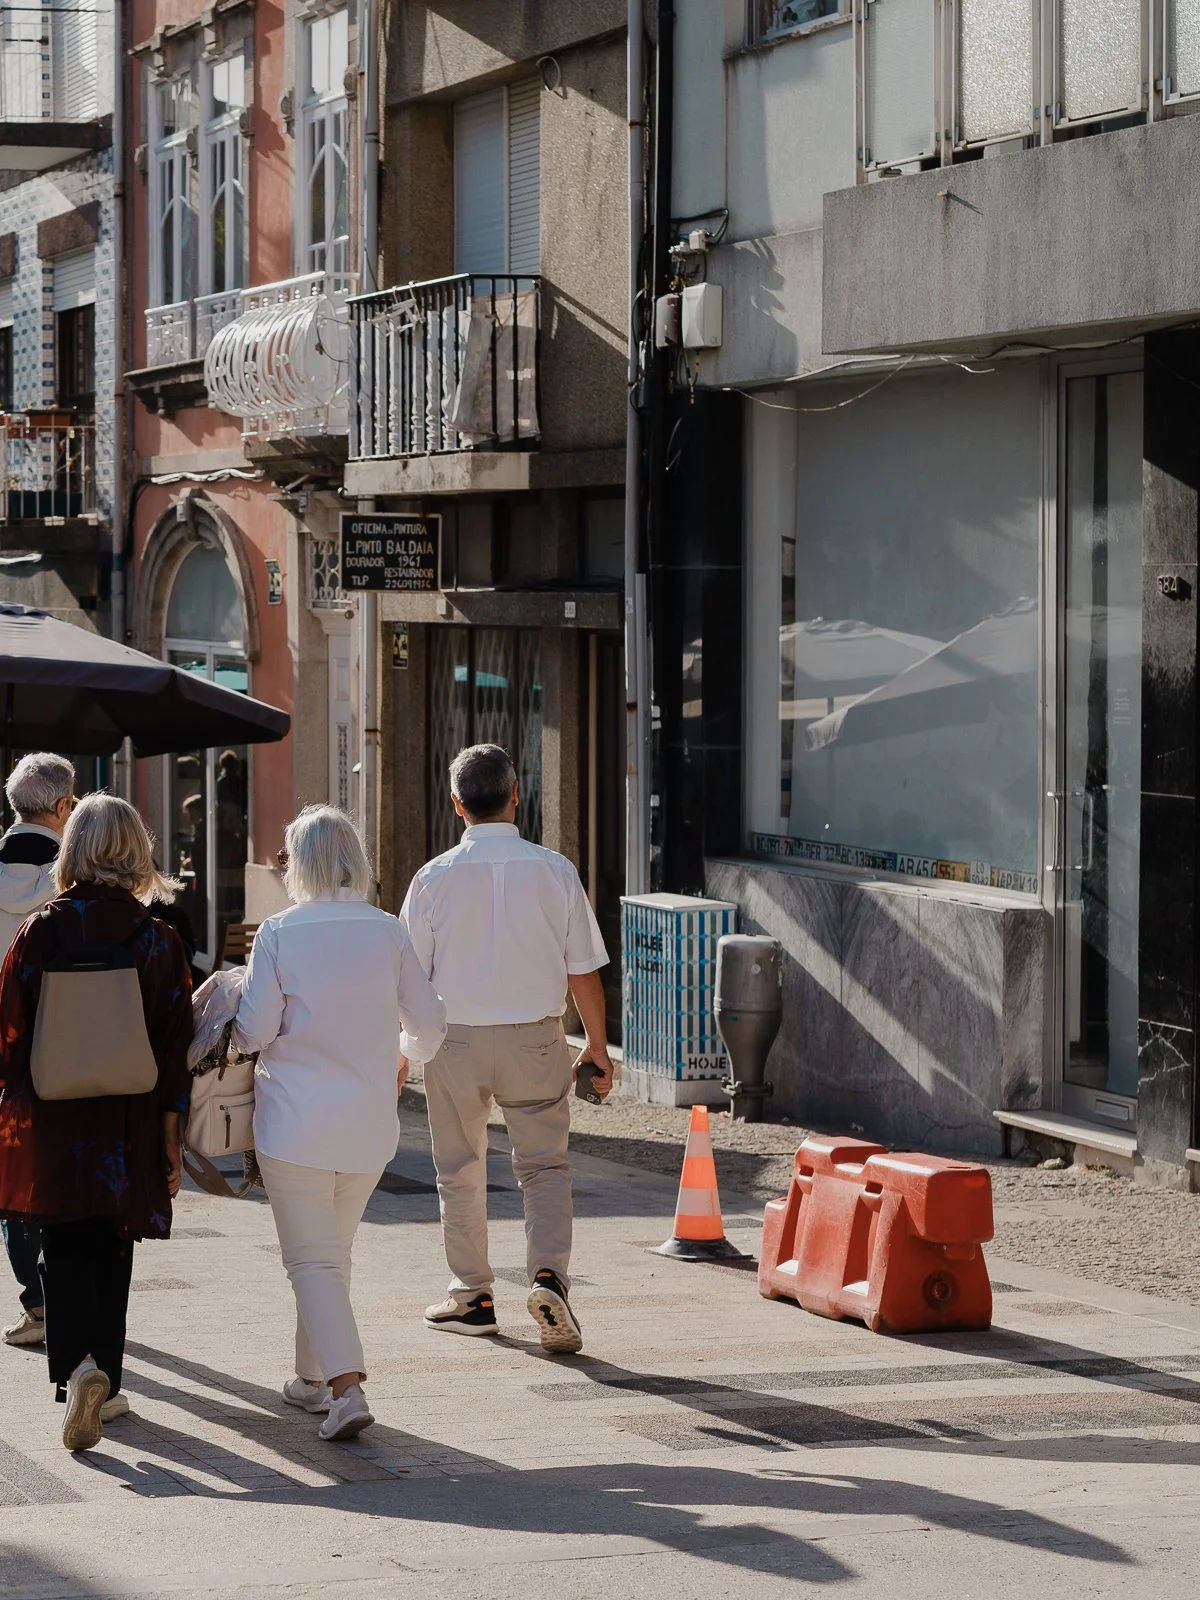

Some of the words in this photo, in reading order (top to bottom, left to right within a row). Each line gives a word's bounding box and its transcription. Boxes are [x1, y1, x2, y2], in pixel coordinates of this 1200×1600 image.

[351, 522, 387, 534] OFICINA
[393, 523, 428, 535] PINTURA
[386, 540, 434, 554] BALDAIA
[346, 556, 385, 567] DOURADOR
[398, 555, 421, 567] 1961
[384, 568, 434, 579] RESTAURADOR
[688, 1056, 727, 1070] HOJE
